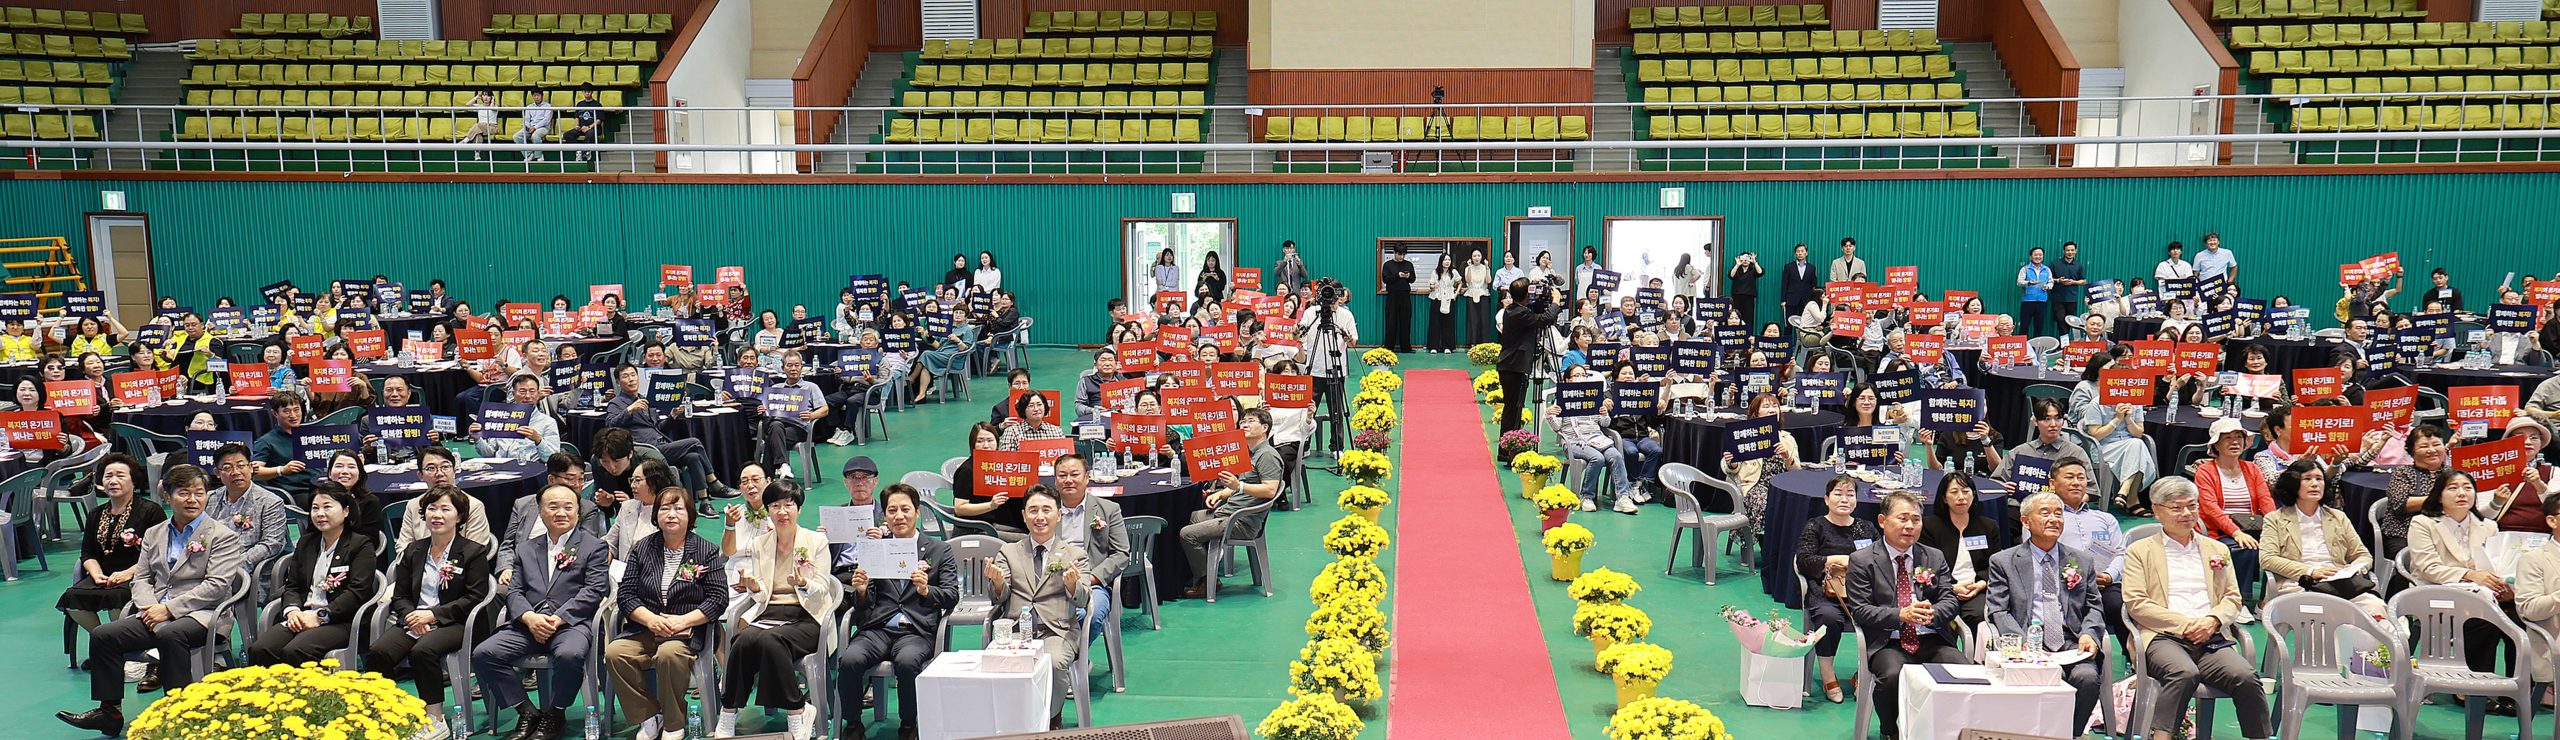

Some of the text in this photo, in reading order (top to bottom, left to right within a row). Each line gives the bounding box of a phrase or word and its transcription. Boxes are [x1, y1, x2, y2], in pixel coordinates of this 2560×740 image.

[1217, 371, 1234, 379] 복지의
[1219, 380, 1252, 389] 빛나는 함평!
[1269, 382, 1307, 391] 복지의 온기로!
[1801, 378, 1824, 387] 함께하는
[1875, 379, 1898, 388] 함께하는
[2106, 377, 2149, 386] 복지의 온기로!
[49, 389, 92, 398] 복지의 온기로!
[1272, 393, 1304, 401] 빛나는 함평!
[1562, 389, 1585, 398] 함께하는
[1619, 389, 1641, 397] 함께하는
[1804, 390, 1821, 398] 행복한
[1880, 391, 1897, 399] 행복한
[2109, 388, 2144, 397] 빛나는 함평!
[54, 398, 91, 408] 빛나는 함평!
[1564, 402, 1582, 410] 행복한
[1621, 400, 1638, 409] 행복한
[1928, 398, 1976, 408] 함께하는 복지!
[2370, 400, 2391, 410] 복지의
[484, 410, 526, 419] 함께하는 복지!
[1193, 412, 1207, 420] 복지의
[1931, 412, 1972, 423] 행복한 함평!
[2372, 412, 2393, 421] 빛나는
[7, 420, 54, 430] 복지의 온기로!
[376, 415, 423, 425] 함께하는 복지!
[2298, 418, 2354, 429] 복지의 온기로!
[484, 422, 520, 431] 행복한 함평!
[1116, 422, 1159, 433] 복지의 온기로!
[1196, 423, 1211, 433] 빛나는
[12, 431, 52, 440] 빛나는 함평!
[380, 428, 420, 439] 행복한 함평!
[1733, 427, 1759, 440] 함께하는
[2302, 431, 2349, 442] 빛나는 함평!
[300, 435, 351, 445] 함께하는 복지!
[1119, 433, 1156, 445] 빛나는 함평!
[1843, 435, 1872, 445] 함께하는
[1192, 442, 1240, 459] 복지의 온기로!
[1737, 442, 1757, 454] 행복한
[305, 450, 329, 459] 행복한
[1848, 448, 1869, 459] 행복한
[199, 455, 214, 465] 행복
[1198, 454, 1240, 470] 빛나는 함평!
[2461, 450, 2519, 468] 복지의 온기로!
[980, 462, 1031, 473] 복지의 온기로!
[2018, 465, 2047, 480] 함께하는
[2496, 464, 2515, 477] 함평!
[984, 475, 1027, 486] 빛나는 함평!
[2018, 480, 2041, 493] 행복한
